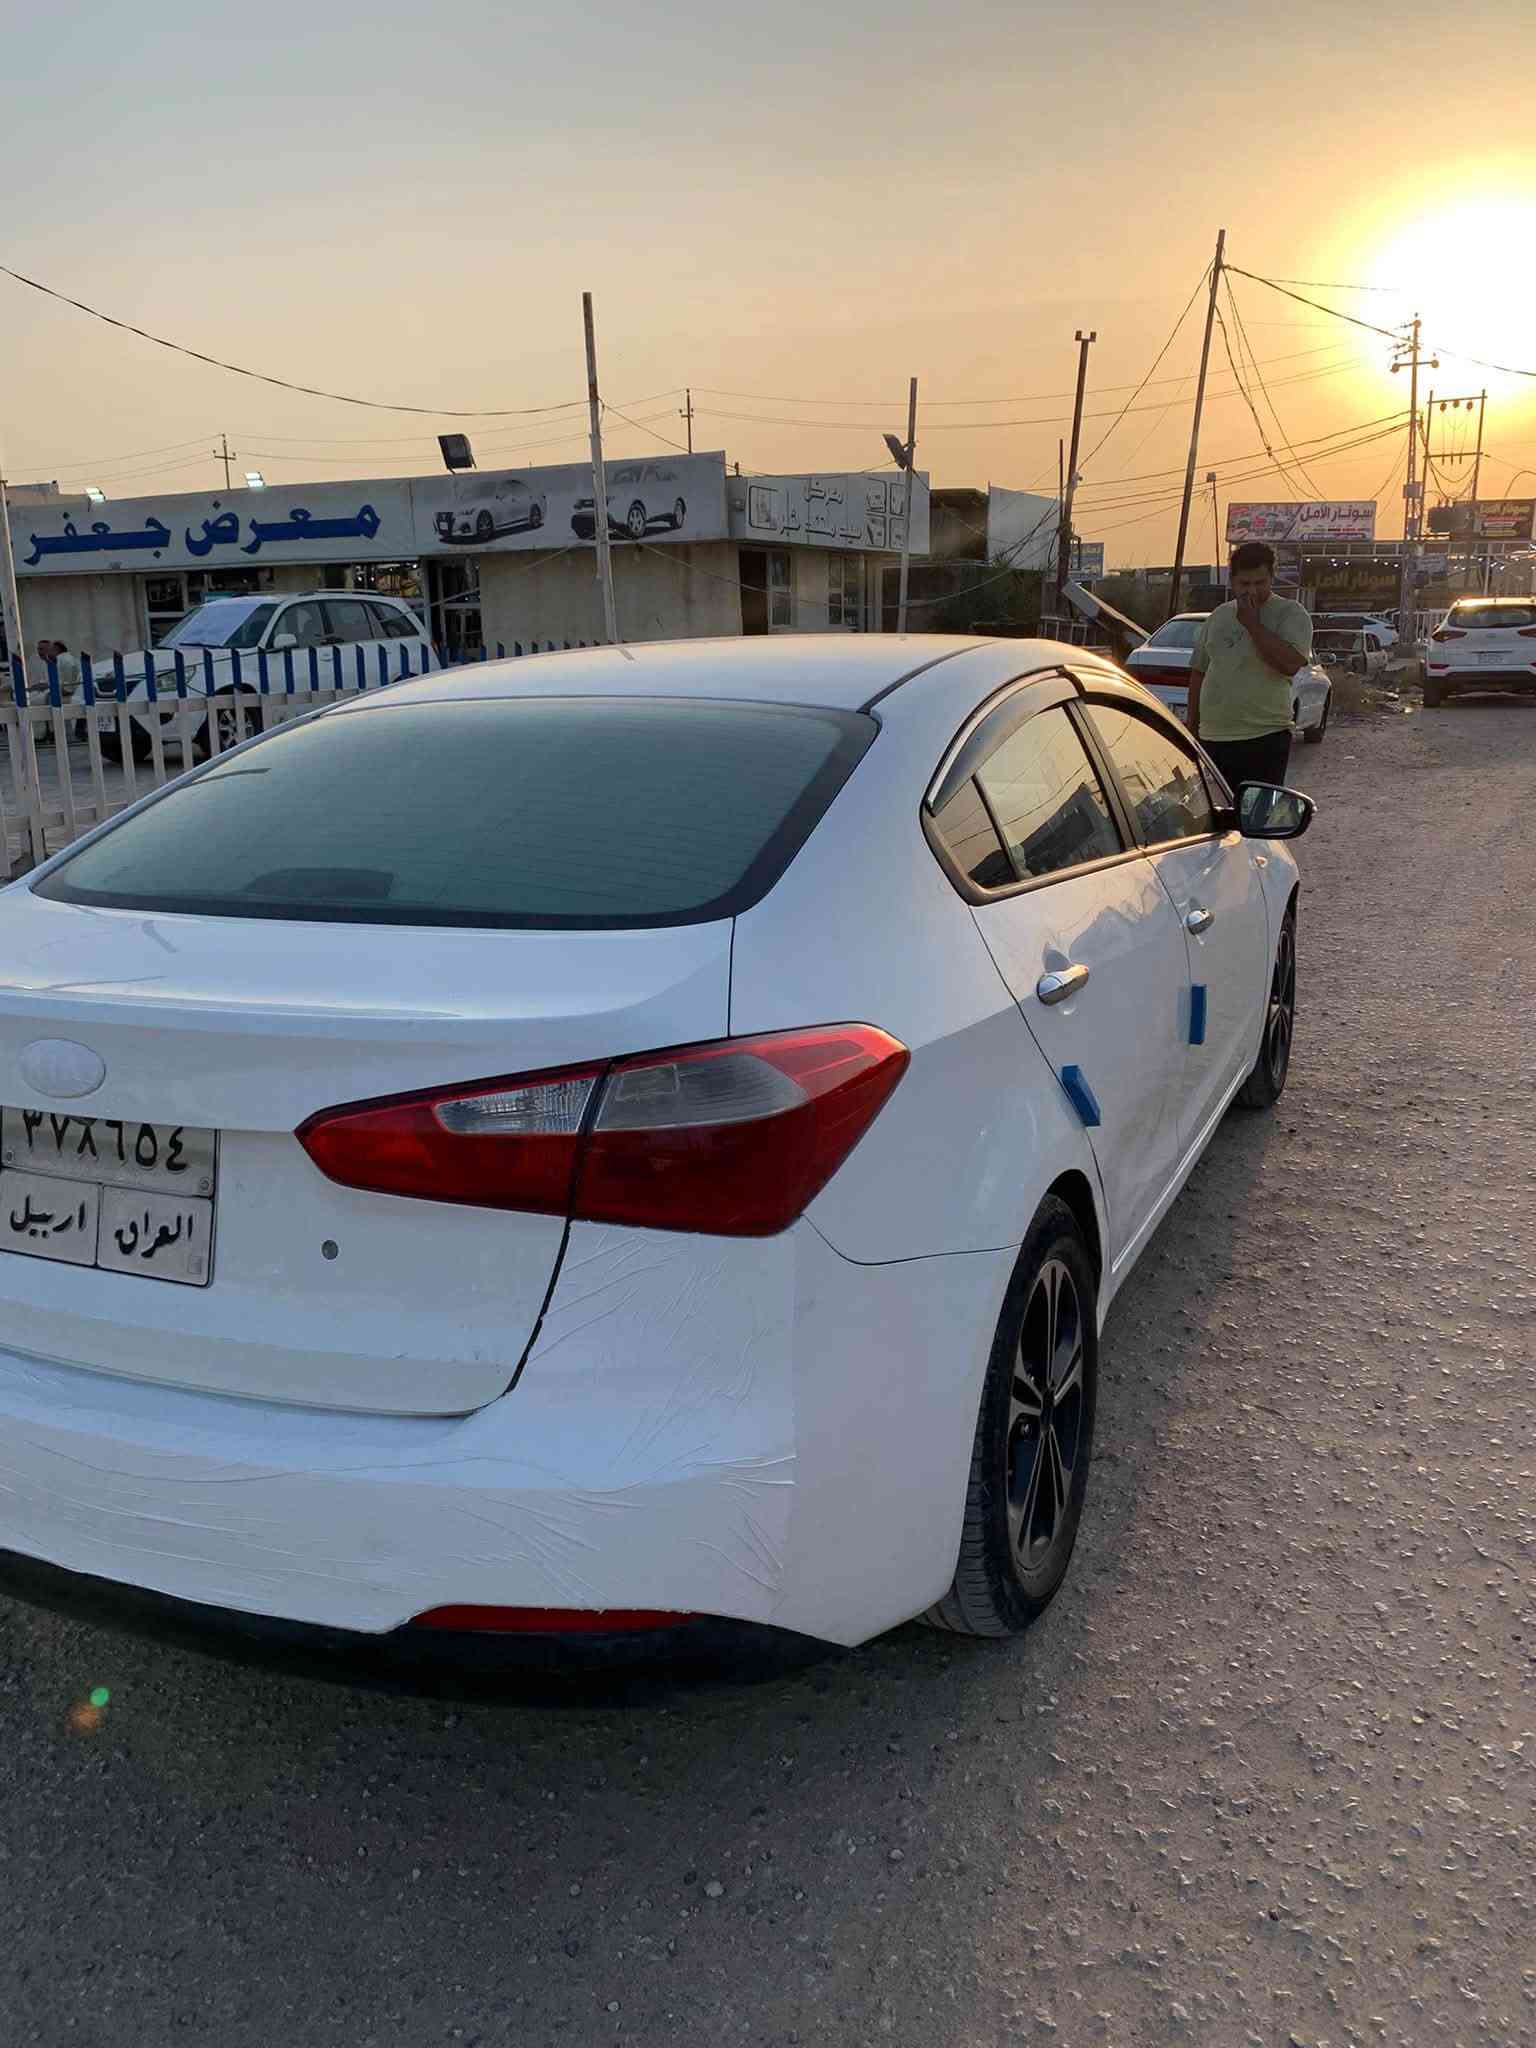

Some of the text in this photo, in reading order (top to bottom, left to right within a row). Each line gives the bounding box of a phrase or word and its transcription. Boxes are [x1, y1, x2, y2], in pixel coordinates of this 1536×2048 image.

[23, 499, 382, 567] معرض جعفر
[9, 1194, 86, 1238] اربيل
[114, 1208, 194, 1259] العراق
